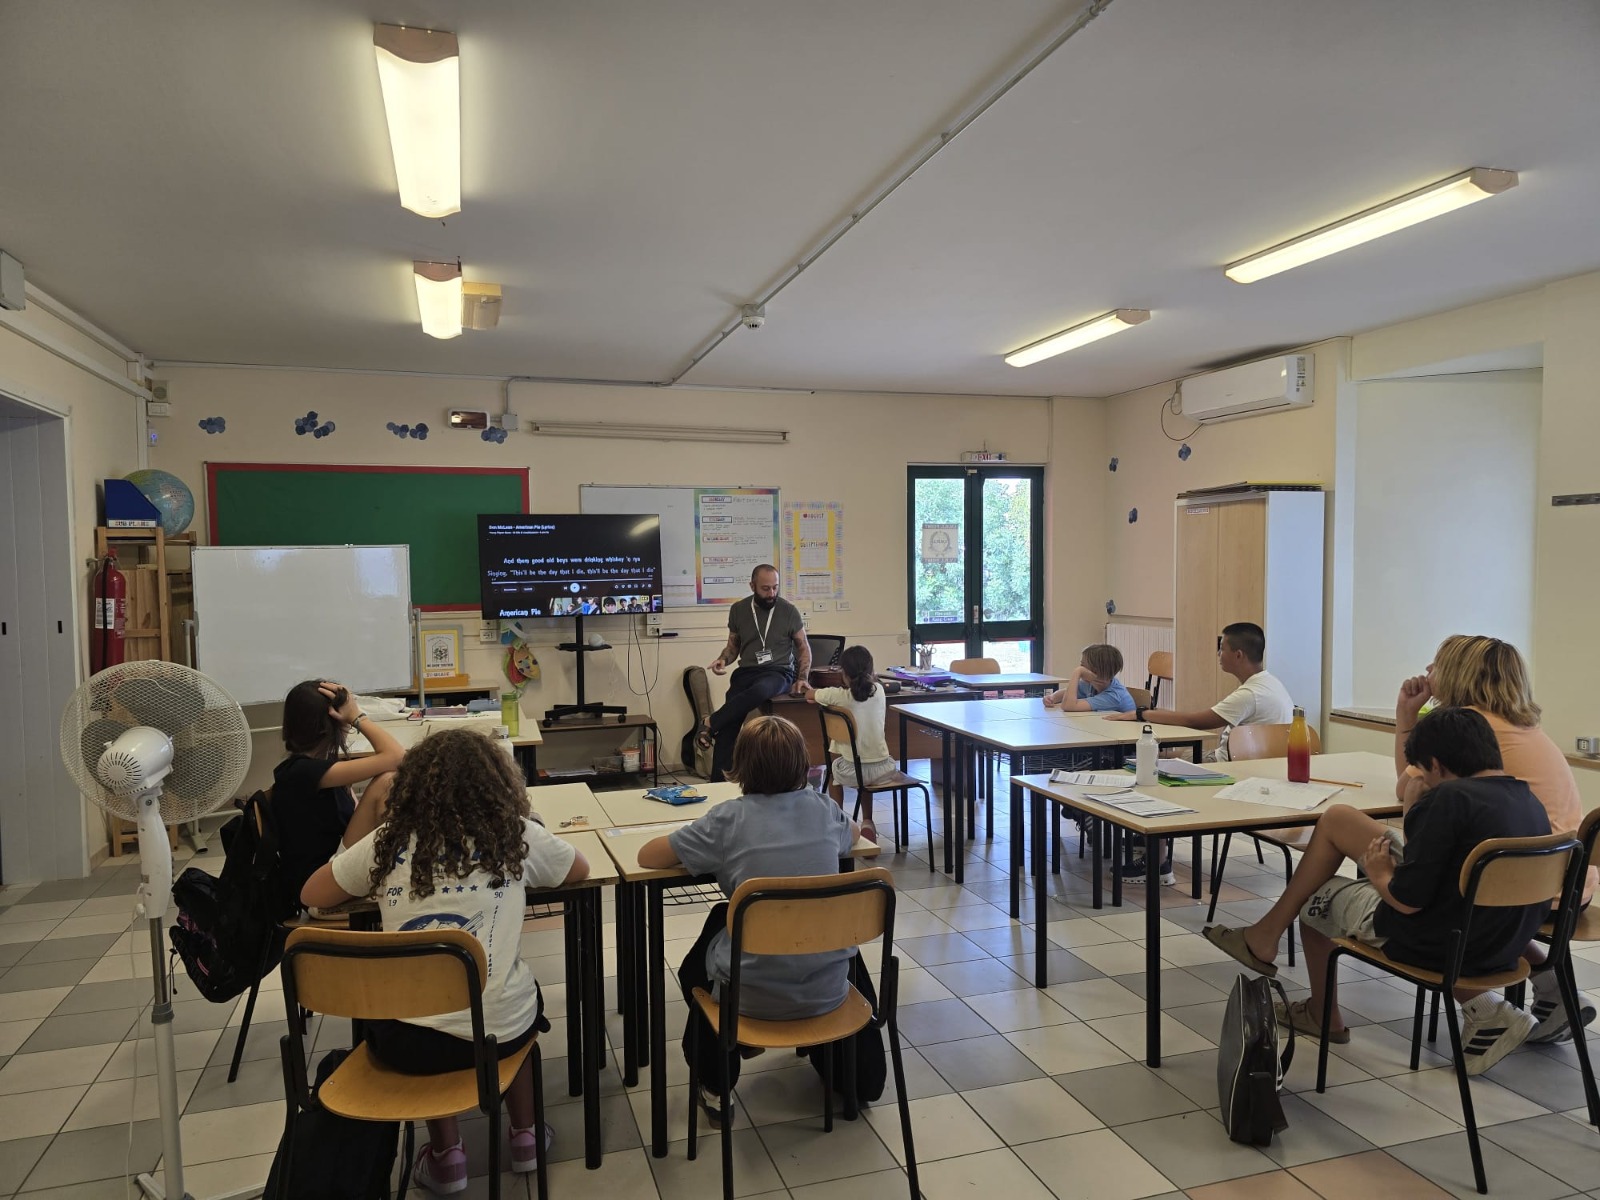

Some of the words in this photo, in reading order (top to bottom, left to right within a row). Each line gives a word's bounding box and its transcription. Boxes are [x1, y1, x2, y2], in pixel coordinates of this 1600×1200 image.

[503, 557, 514, 565] And
[556, 557, 568, 565] boys
[584, 556, 603, 564] drinking
[605, 556, 624, 564] whiskey
[548, 569, 558, 577] day
[559, 568, 570, 576] that
[620, 567, 630, 575] day
[499, 608, 529, 617] American
[530, 608, 541, 616] Pie
[487, 879, 511, 889] MRE
[386, 886, 403, 897] FOR
[494, 891, 504, 899] 90
